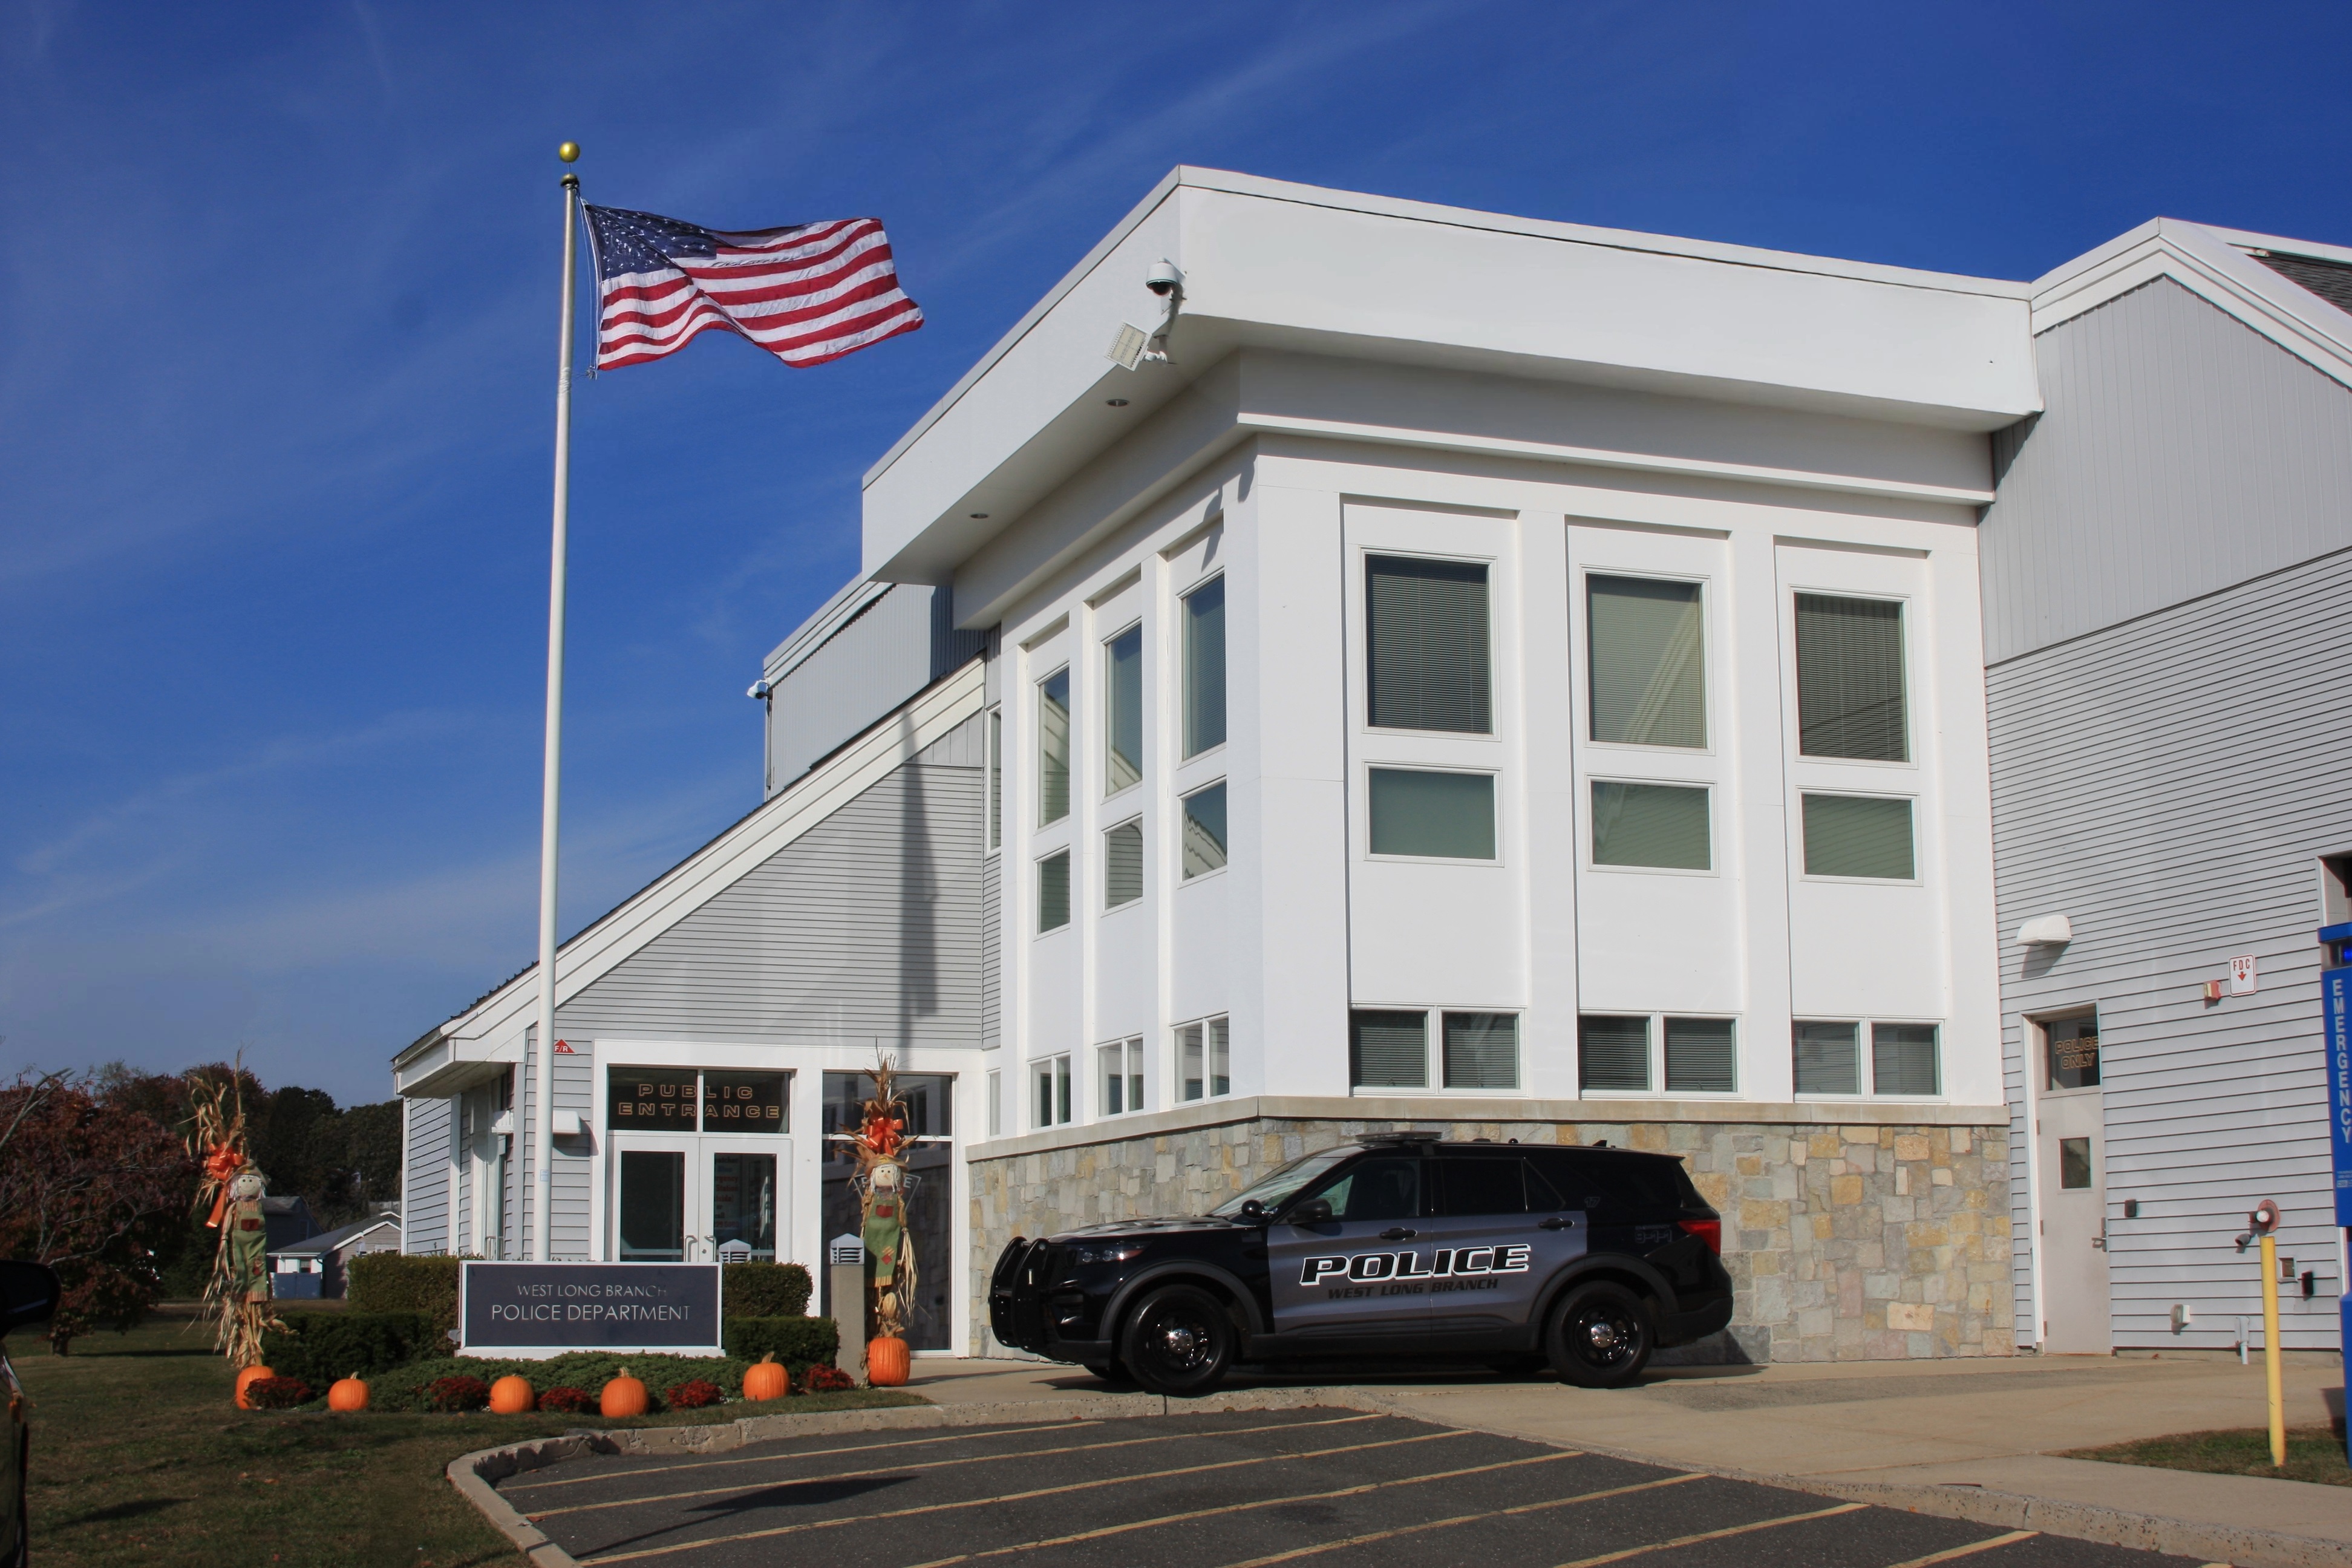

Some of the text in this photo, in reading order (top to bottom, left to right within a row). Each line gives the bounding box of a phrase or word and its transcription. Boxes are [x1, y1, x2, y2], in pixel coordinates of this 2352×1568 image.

[2055, 1036, 2099, 1054] POLICE
[2061, 1053, 2096, 1069] ONLY
[2332, 978, 2352, 1144] EMERGENCY
[638, 1083, 753, 1099] PUBLIC
[618, 1102, 780, 1119] ENTRANCE
[1584, 1196, 1601, 1208] 17
[1635, 1229, 1673, 1244] 9-1-1
[1299, 1243, 1531, 1286] POLICE
[517, 1284, 667, 1297] WEST LONG BRANCH
[1328, 1278, 1498, 1300] WEST LONG BRANCH
[491, 1304, 690, 1321] POLICE DEPARTMENT
